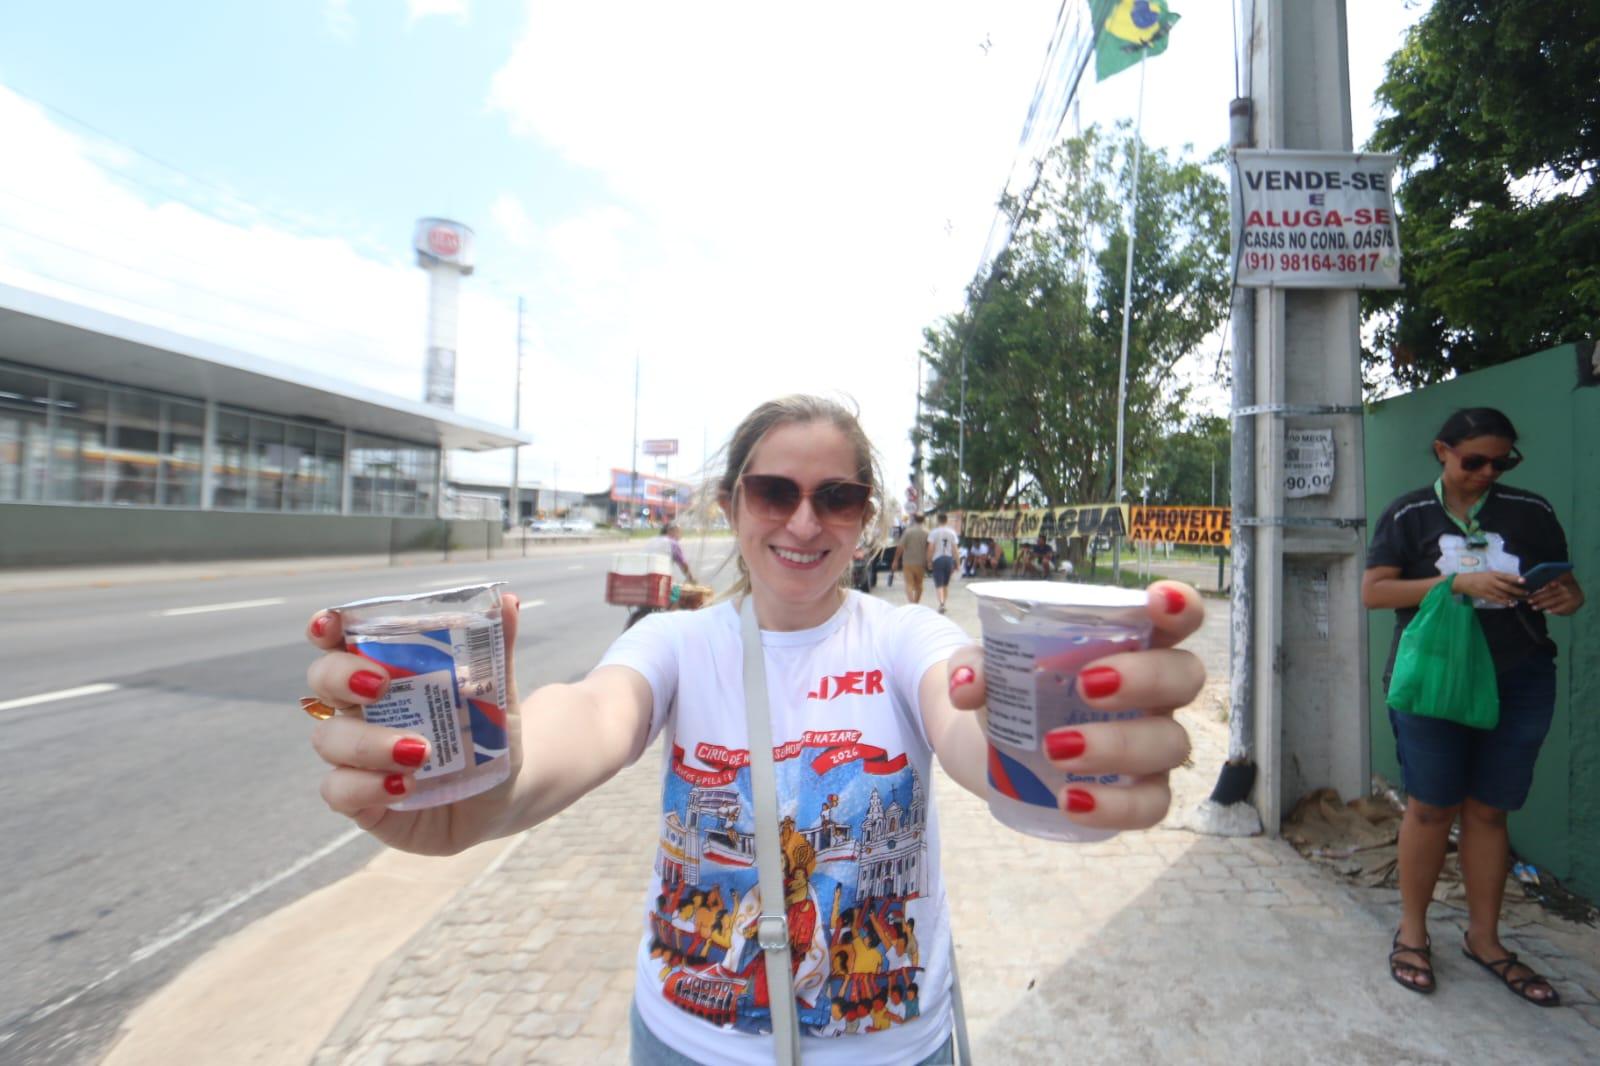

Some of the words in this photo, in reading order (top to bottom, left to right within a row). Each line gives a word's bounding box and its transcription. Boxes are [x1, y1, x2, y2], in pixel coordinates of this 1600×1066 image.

[1245, 171, 1386, 192] VENDE-SE
[1308, 193, 1325, 206] E
[1245, 208, 1391, 227] ALUGA-SE
[1244, 231, 1285, 248] CASAS
[1289, 231, 1307, 248] NO
[1310, 231, 1349, 249] COND.
[1245, 252, 1275, 271] (91)
[1280, 253, 1380, 272] 98164-3617
[1133, 508, 1231, 529] APROVEITE
[829, 747, 859, 765] 2026
